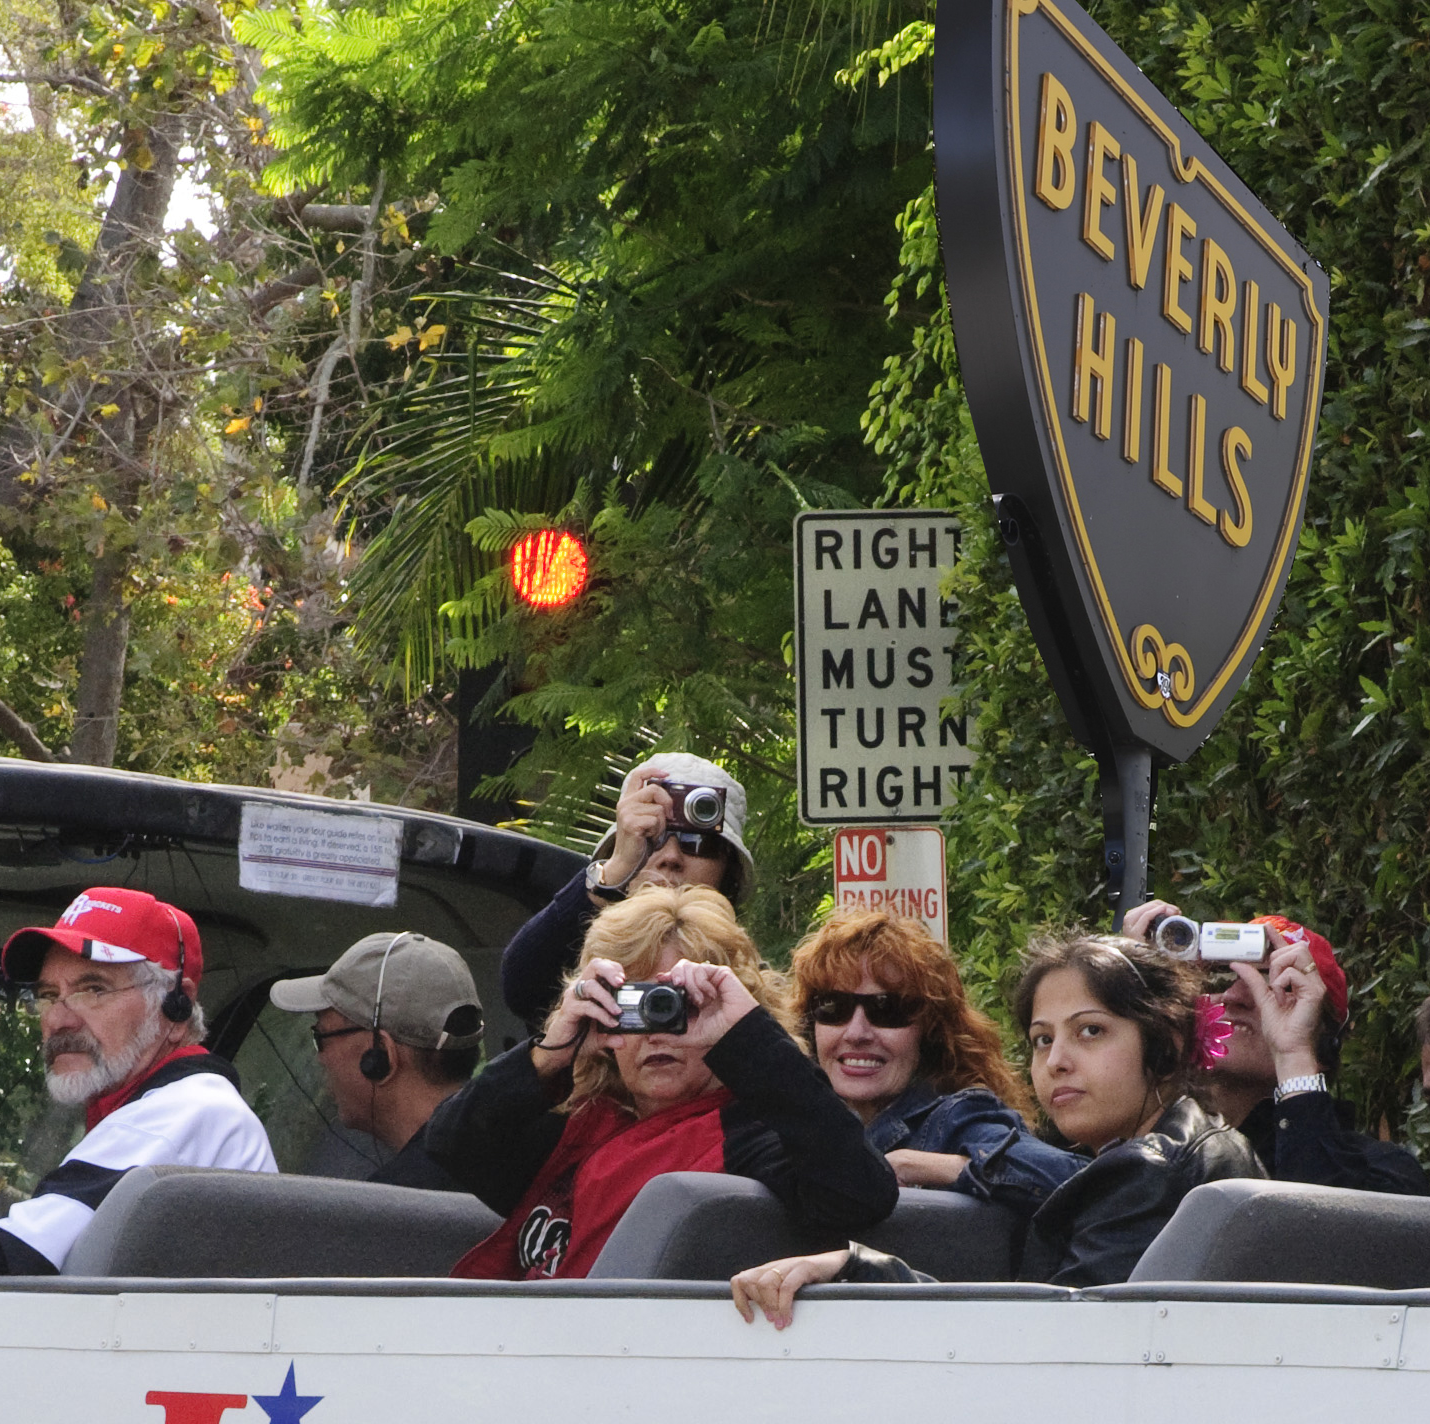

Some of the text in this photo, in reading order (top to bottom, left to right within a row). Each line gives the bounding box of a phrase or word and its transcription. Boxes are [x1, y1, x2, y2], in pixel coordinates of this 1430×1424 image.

[1036, 72, 1297, 421] BEVERLY
[1072, 292, 1253, 548] HILLS
[815, 527, 962, 570] RIGHT
[820, 706, 968, 749] TURN
[820, 765, 971, 808] RIGHT
[839, 834, 883, 876] NO
[843, 887, 938, 919] PARKING
